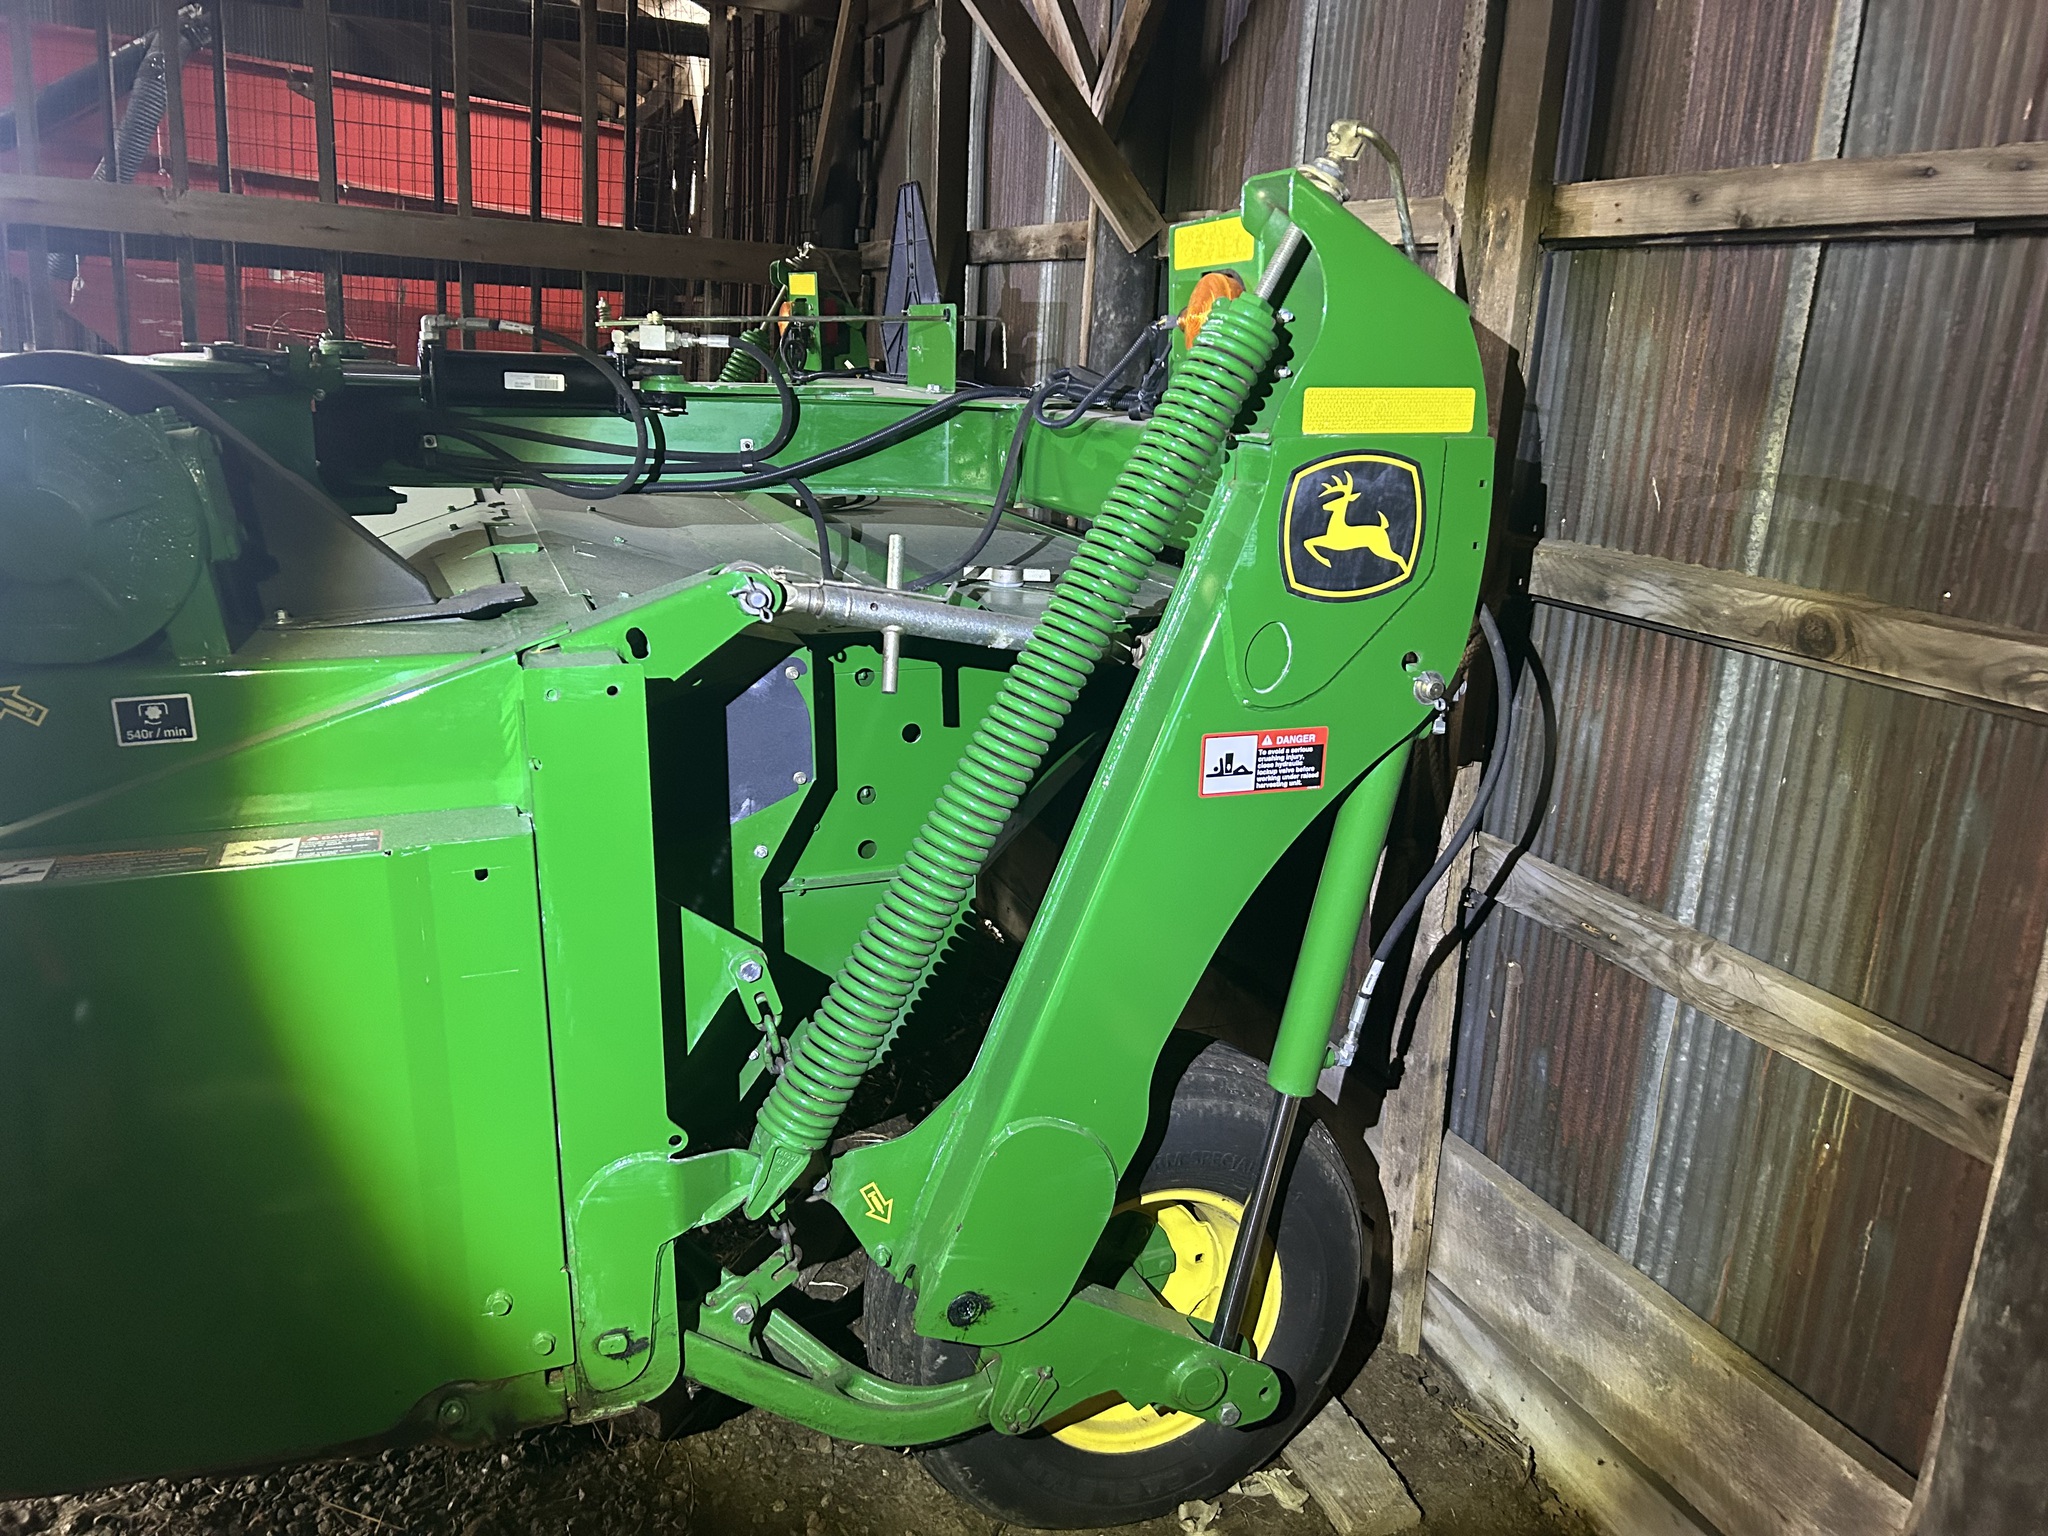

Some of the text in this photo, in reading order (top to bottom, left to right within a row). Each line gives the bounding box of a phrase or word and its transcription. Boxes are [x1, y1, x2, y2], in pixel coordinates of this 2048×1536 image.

[126, 729, 154, 740] 540r
[163, 726, 187, 737] min
[1276, 733, 1316, 745] DANGER
[1267, 747, 1285, 755] avoid
[1257, 753, 1305, 763] crushing injury,
[1274, 760, 1304, 768] hydraulic
[1256, 768, 1278, 776] lockup
[1295, 765, 1316, 773] before
[1256, 775, 1281, 783] working
[1300, 771, 1320, 779] raised
[1255, 781, 1288, 789] harvesting
[321, 831, 374, 840] DANGER
